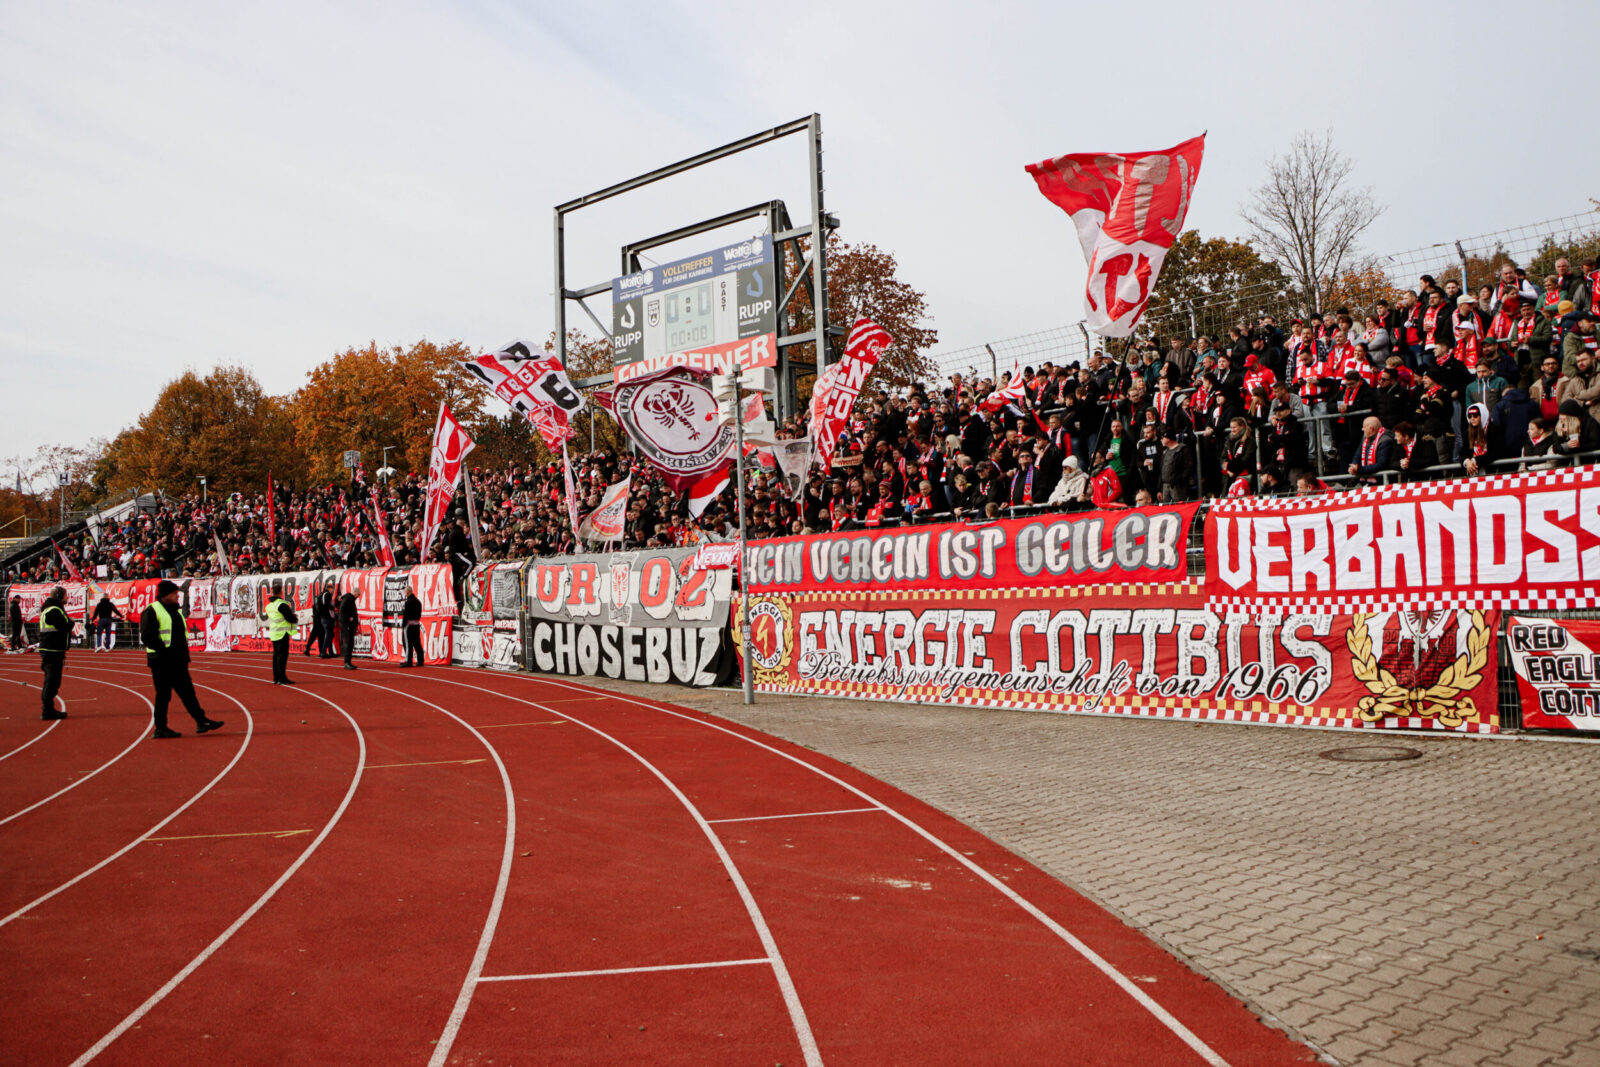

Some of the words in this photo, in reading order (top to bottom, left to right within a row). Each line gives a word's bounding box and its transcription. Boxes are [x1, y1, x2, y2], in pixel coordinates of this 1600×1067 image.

[662, 256, 714, 277] VOLLTREFFER
[739, 300, 773, 320] RUPP
[614, 331, 642, 348] RUPP
[809, 530, 931, 583] VEREIN
[939, 526, 1006, 580] IST
[1015, 511, 1183, 577] GEILER
[533, 622, 721, 686] CHOSEBUZ
[799, 609, 997, 675] ENERGIE
[1010, 608, 1334, 696] COTTBUS
[1512, 624, 1568, 652] RED
[799, 650, 1133, 709] Betriebssportgemeinschaft
[1139, 676, 1207, 697] von
[1216, 662, 1328, 706] 1966
